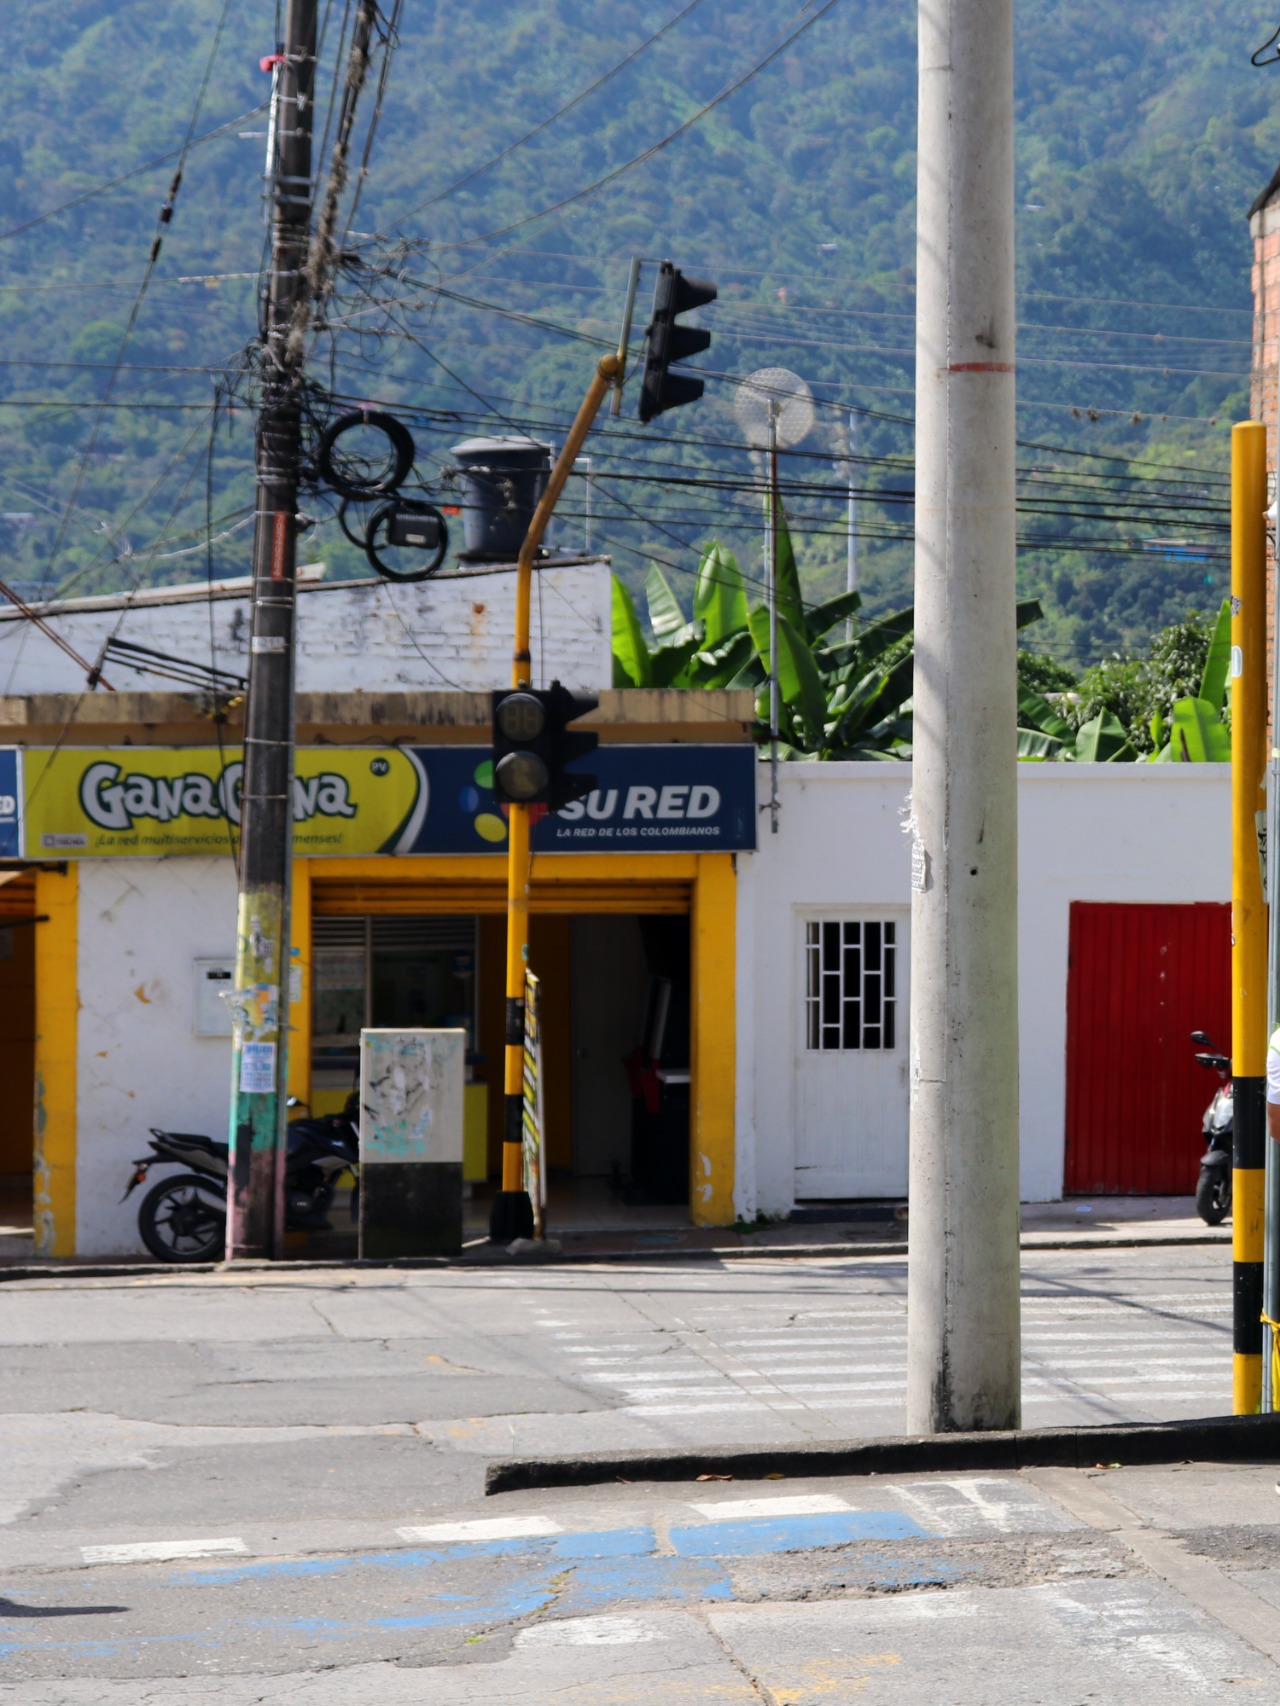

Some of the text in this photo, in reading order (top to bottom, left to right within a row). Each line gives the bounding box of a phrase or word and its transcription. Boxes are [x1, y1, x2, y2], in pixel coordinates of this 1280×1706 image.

[556, 785, 721, 820] SU RED
[556, 826, 720, 837] LA RED DE LOS COLOMBIANOS
